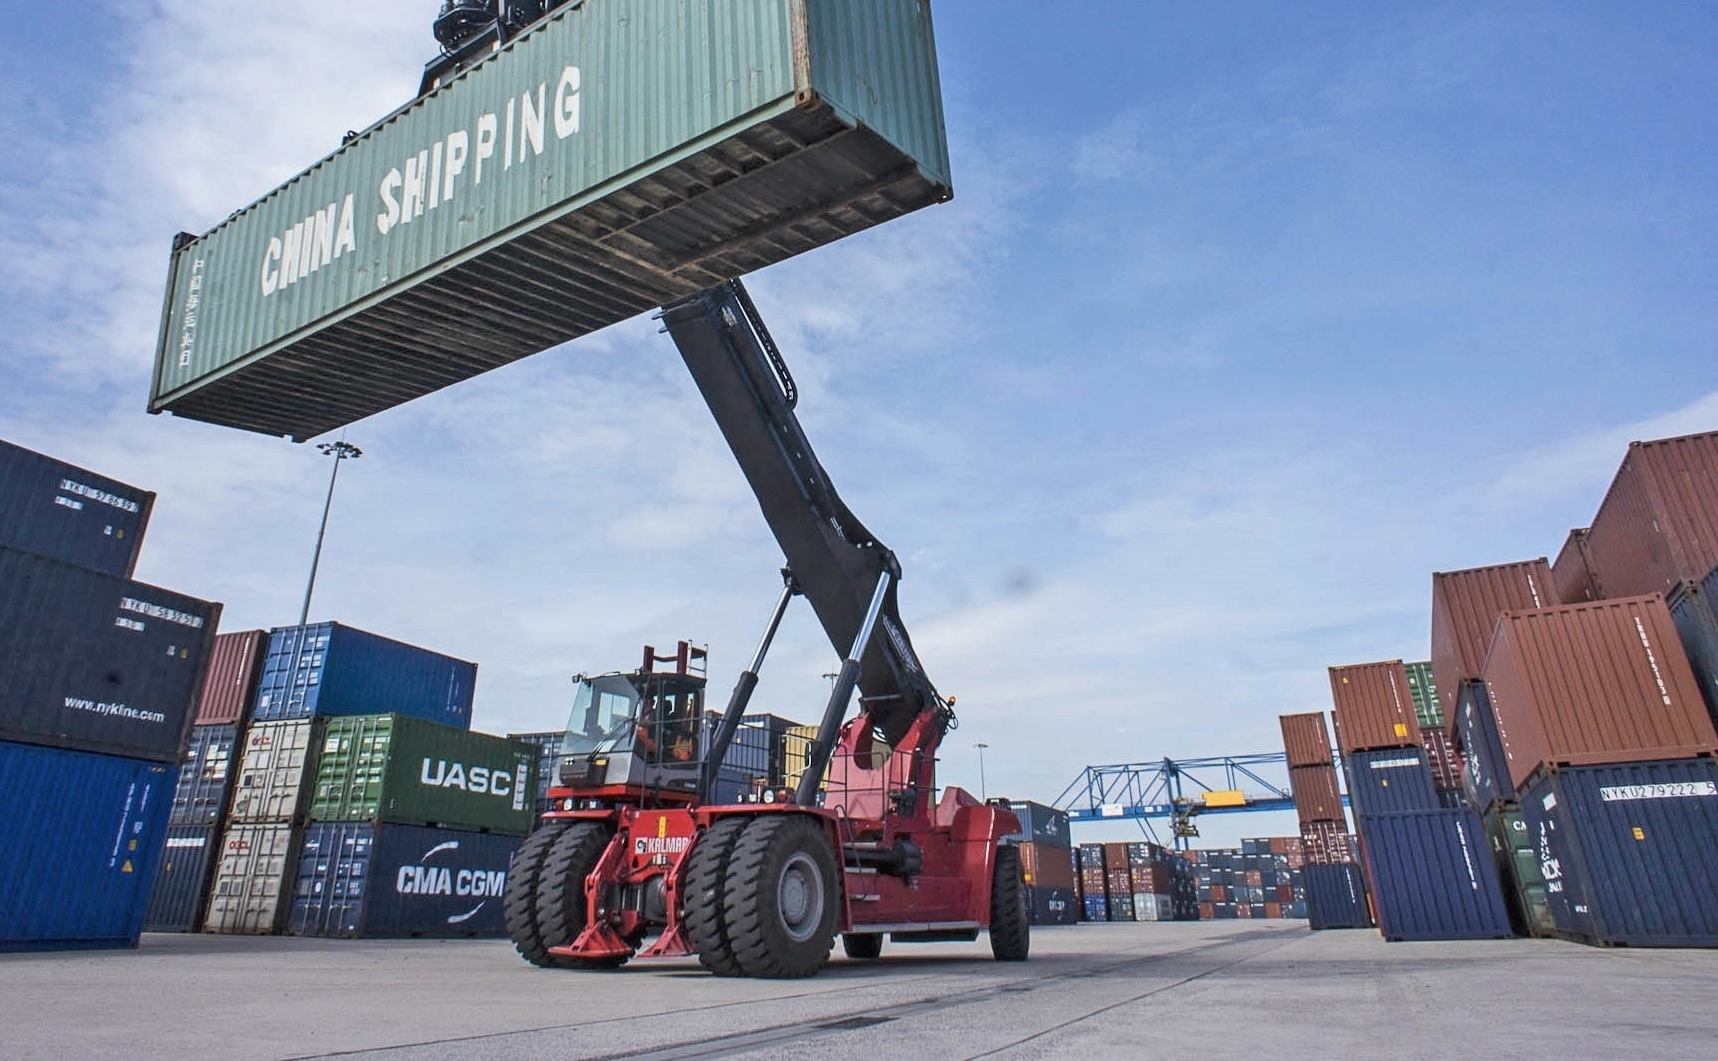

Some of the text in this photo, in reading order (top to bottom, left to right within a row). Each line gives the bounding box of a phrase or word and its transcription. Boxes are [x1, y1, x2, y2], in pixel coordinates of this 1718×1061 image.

[261, 65, 581, 297] CHINA SHIPPING
[120, 596, 150, 613] NYKU
[64, 696, 165, 723] www.nykline.com
[421, 757, 511, 796] UASC
[396, 865, 452, 895] CMA
[456, 869, 506, 898] CGM
